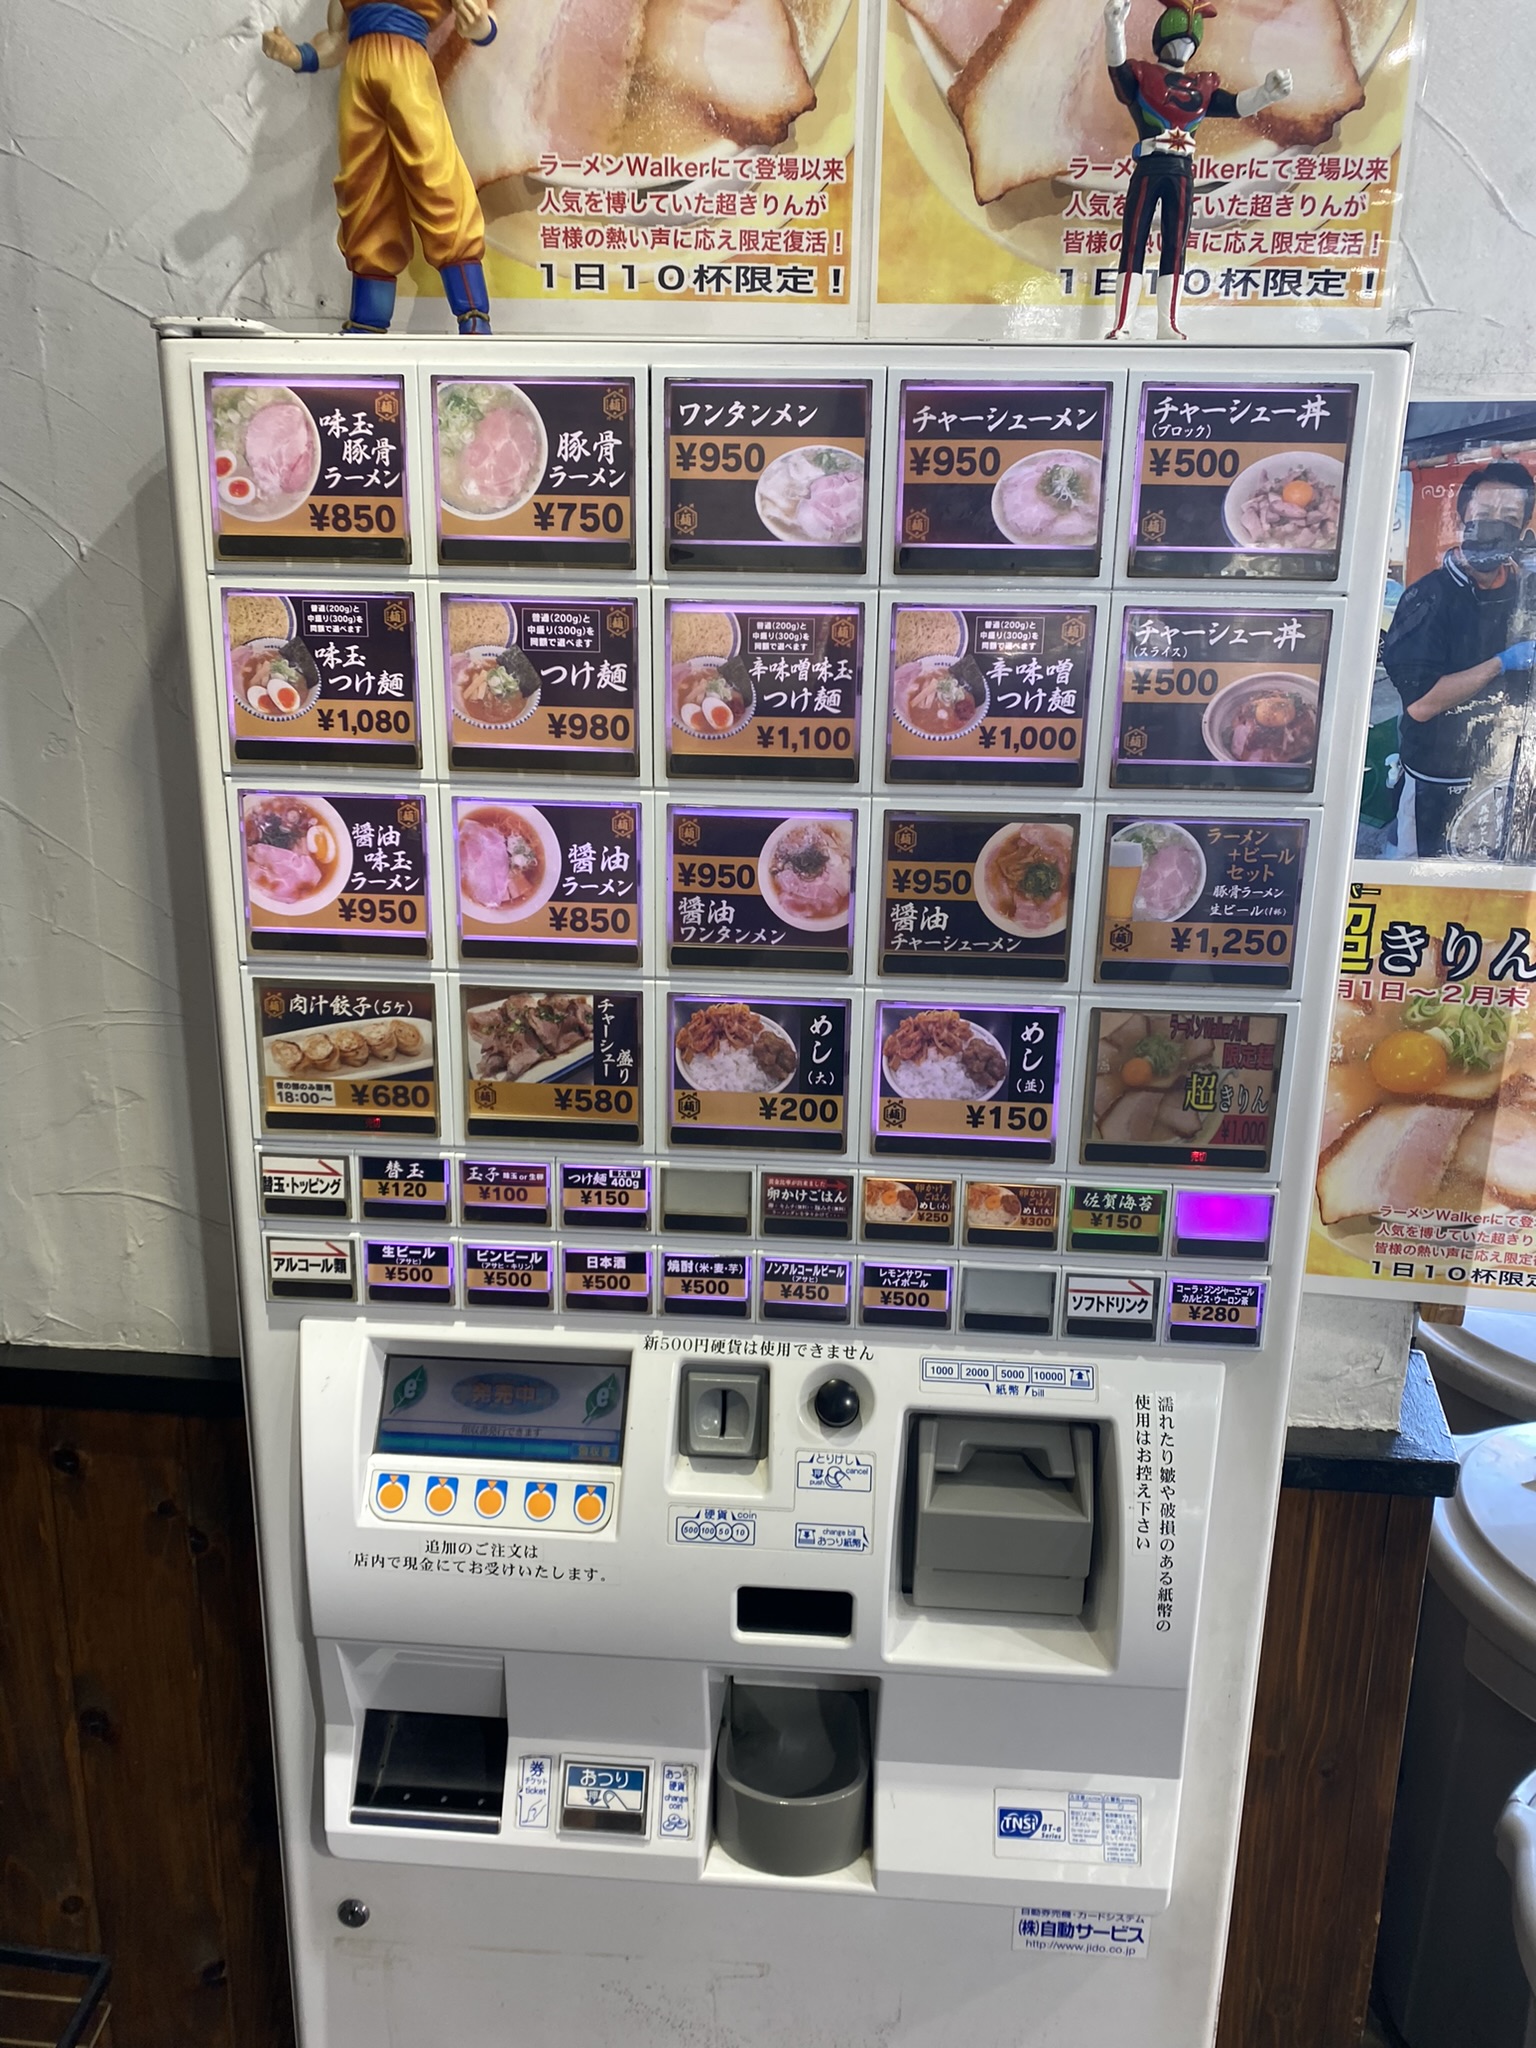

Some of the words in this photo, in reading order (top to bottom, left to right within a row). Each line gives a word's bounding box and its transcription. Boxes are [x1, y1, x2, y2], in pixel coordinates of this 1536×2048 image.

[539, 155, 844, 181] ラーメンWalkerにて登場以来
[540, 191, 827, 217] 人気を博していた超きりんが
[540, 227, 842, 254] 皆様の熱い声に応え限定復活！
[678, 401, 818, 429] ワンタンメン
[912, 404, 1098, 433] チャーシューメン
[1153, 394, 1331, 430] チャーシュー丼
[318, 412, 374, 438] 味玉
[341, 439, 397, 464] 豚骨
[557, 431, 622, 463] 豚骨
[675, 442, 765, 473] ¥950
[910, 446, 1000, 477] ¥950
[1149, 448, 1239, 478] ¥500
[324, 465, 401, 489] ラーメン
[548, 464, 627, 489] ラーメン
[309, 503, 396, 533] ¥850
[534, 502, 624, 533] ¥750
[1135, 618, 1306, 652] チャーシュー丼
[314, 642, 366, 669] 味玉
[540, 659, 628, 692] つけ麺
[749, 657, 854, 682] 辛味噌味玉
[986, 657, 1073, 686] 辛味噌
[328, 670, 405, 697] つけ麺
[1131, 668, 1218, 696] ¥500
[763, 686, 842, 714] つけ麺
[997, 686, 1077, 715] つけ麺
[317, 709, 410, 736] ¥1,080
[547, 713, 630, 741] ¥980
[757, 726, 850, 752] ¥1,100
[979, 726, 1076, 753] ¥1,000
[352, 822, 401, 849] 醤油
[1207, 828, 1270, 845] ラーメン
[364, 849, 412, 873] 味玉
[568, 842, 630, 874] 醤油
[350, 872, 420, 893] ラーメン
[678, 862, 755, 889] ¥950
[892, 869, 971, 895] ¥950
[1226, 864, 1275, 883] セット
[562, 875, 634, 897] ラーメン
[1212, 885, 1284, 899] 豚骨ラーメン
[338, 898, 417, 925] ¥950
[549, 907, 630, 933] ¥850
[678, 896, 735, 925] 醤油
[890, 903, 949, 933] 醤油
[679, 925, 786, 946] ワンタンメン
[891, 934, 1022, 953] チャーシューメン
[1170, 927, 1288, 957] ¥1,250
[598, 998, 615, 1077] チャーシュー
[616, 1049, 633, 1084] 盛り
[351, 1084, 430, 1107] ¥680
[554, 1088, 633, 1113] ¥580
[1183, 1072, 1268, 1114] 超きりん
[759, 1097, 838, 1123] ¥200
[966, 1105, 1048, 1132] ¥150
[384, 1160, 424, 1179] 替玉
[466, 1166, 500, 1182] 玉子
[568, 1172, 608, 1186] つけ麺
[263, 1176, 341, 1195] 替玉・トッピング
[378, 1182, 427, 1197] ¥120
[479, 1186, 528, 1201] ¥100
[611, 1178, 640, 1189] 400g
[580, 1190, 629, 1205] ¥150
[766, 1187, 848, 1204] 卵かけごはん
[1083, 1192, 1153, 1212] 佐賀海苔
[917, 1212, 949, 1223] ¥250
[1020, 1217, 1051, 1227] ¥300
[1091, 1213, 1142, 1229] ¥150
[382, 1246, 435, 1259] 生ビール
[476, 1250, 542, 1264] ビンビール
[586, 1256, 627, 1270] 日本酒
[273, 1258, 347, 1274] アルコール類
[385, 1267, 433, 1282] ¥500
[766, 1262, 845, 1278] ノンアルコールビール
[879, 1268, 931, 1278] レモンサワー
[484, 1271, 532, 1287] ¥500
[582, 1275, 631, 1290] ¥500
[681, 1279, 729, 1295] ¥500
[882, 1277, 929, 1288] ハイボール
[780, 1284, 829, 1300] ¥450
[880, 1290, 930, 1307] ¥500
[1072, 1295, 1149, 1314] ソフトドリンク
[1189, 1305, 1240, 1322] ¥280
[643, 1335, 874, 1361] 新500円硬貨は使用できません
[930, 1366, 953, 1376] 1000
[966, 1368, 989, 1377] 2000
[1001, 1369, 1024, 1379] 5000
[1034, 1371, 1063, 1381] 10000
[1031, 1388, 1044, 1397] bill
[816, 1454, 854, 1465] とりけし
[846, 1467, 869, 1475] cancel
[1134, 1394, 1152, 1550] 使用はお控え下さい
[737, 1511, 757, 1519] coin
[684, 1526, 698, 1534] 500
[701, 1526, 715, 1535] 100
[719, 1528, 730, 1536] 50
[822, 1528, 846, 1537] change
[847, 1528, 856, 1536] bill
[425, 1539, 538, 1559] 追加のご注文は
[353, 1552, 606, 1583] 店内で現金にてお受けいたします。
[530, 1760, 545, 1777] 券
[580, 1769, 629, 1789] おつり
[525, 1787, 546, 1795] ticket
[669, 1802, 683, 1810] coin
